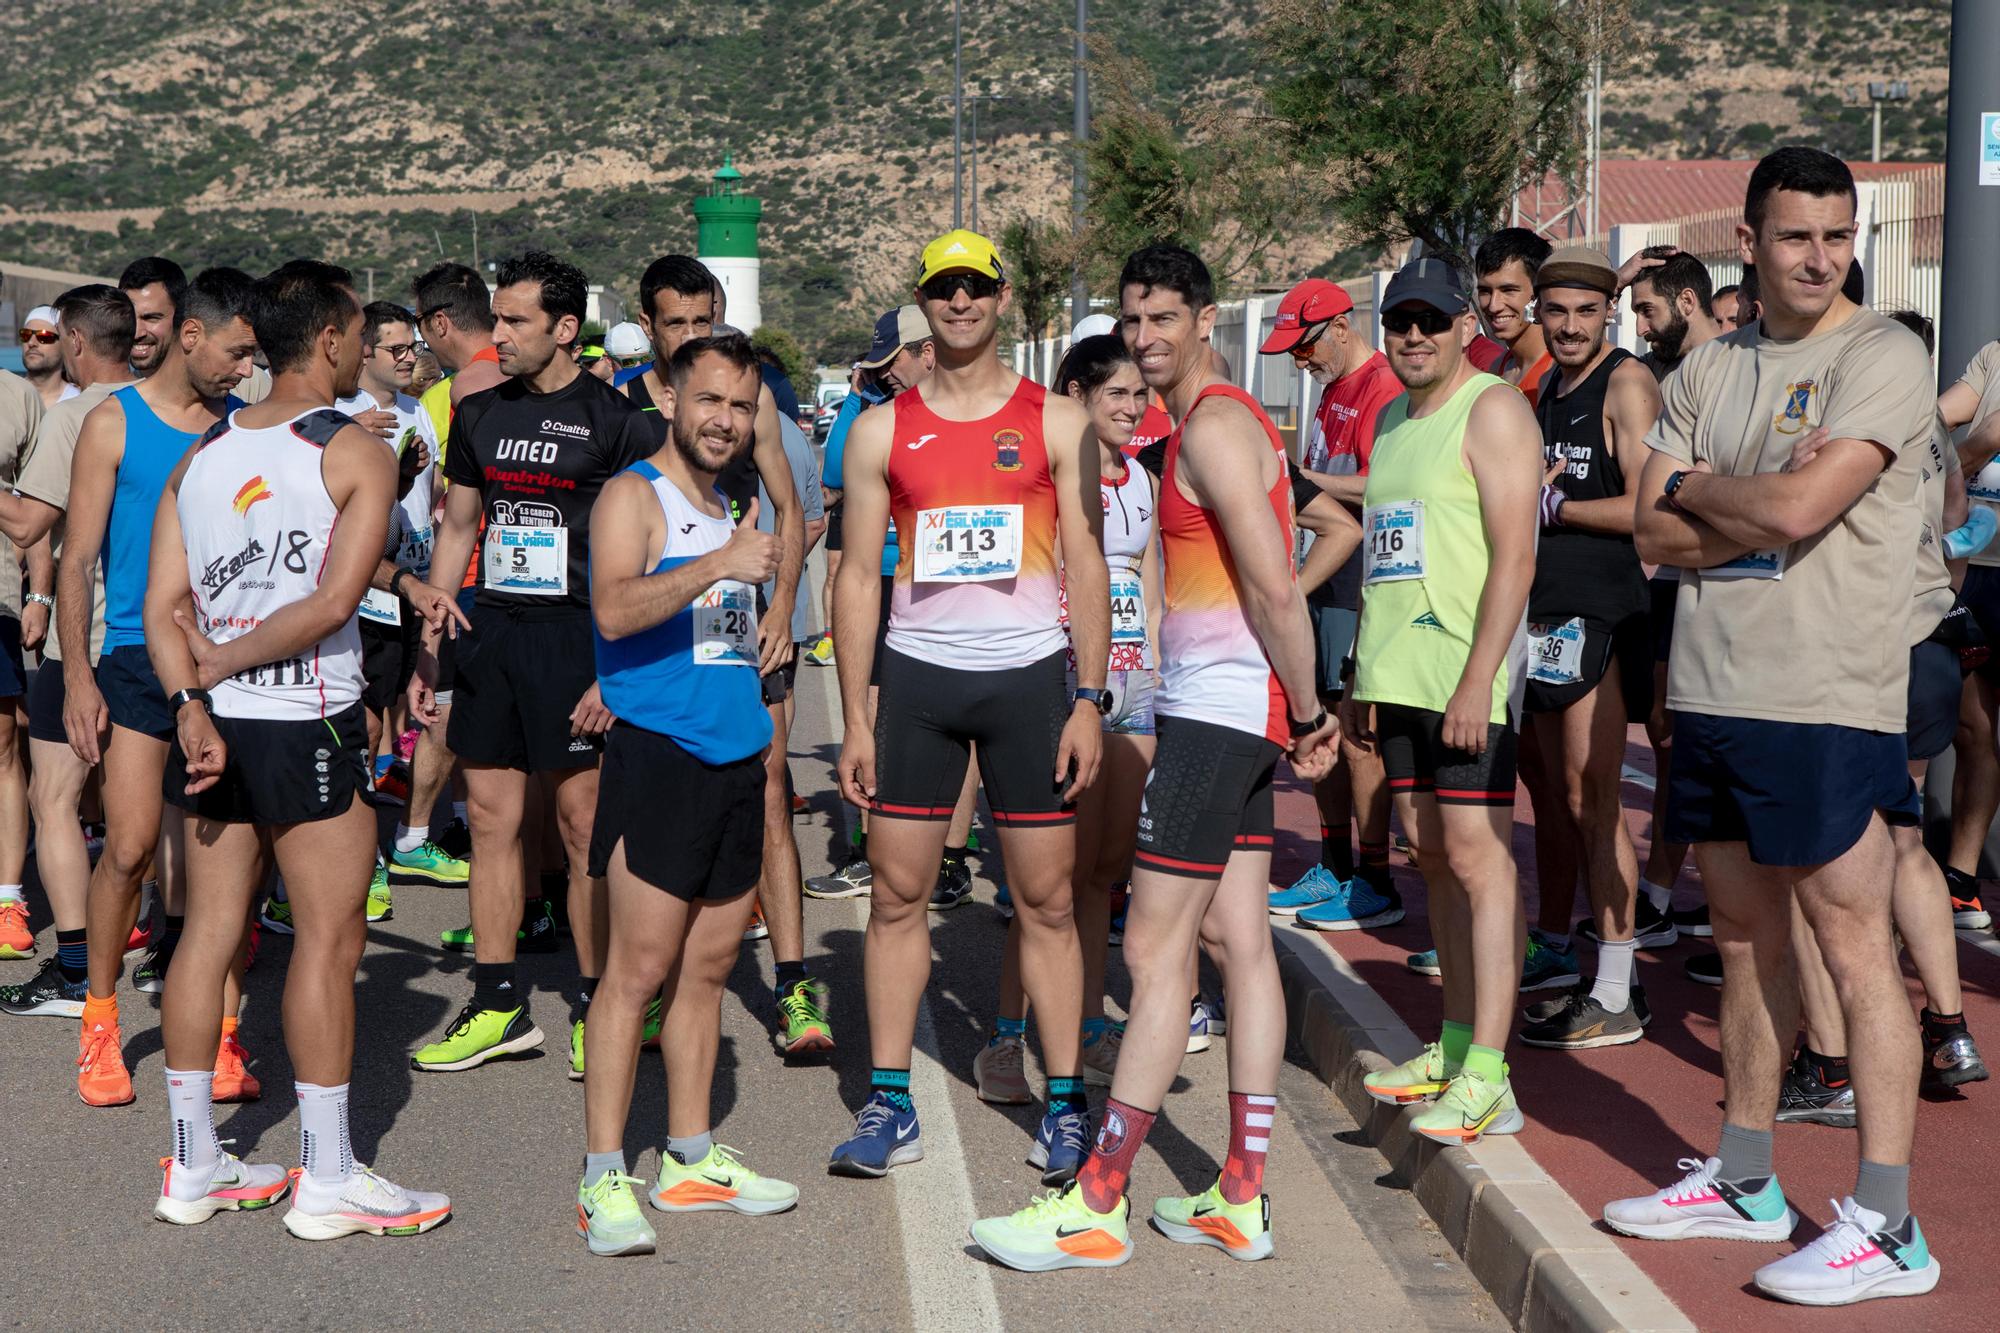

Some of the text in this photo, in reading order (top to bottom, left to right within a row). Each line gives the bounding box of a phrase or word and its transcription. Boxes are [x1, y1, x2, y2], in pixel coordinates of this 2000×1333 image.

[552, 421, 591, 436] Cualtis
[495, 438, 559, 464] UNED
[1930, 440, 1943, 474] OLA
[484, 465, 577, 490] Runtriton
[926, 512, 945, 530] XI
[488, 529, 501, 545] XI
[501, 535, 555, 548] CALVARIO
[939, 528, 996, 553] 113
[1369, 528, 1404, 555] 116
[512, 547, 527, 567] 5
[702, 590, 722, 608] XI
[724, 610, 749, 636] 28
[1543, 636, 1564, 658] 36
